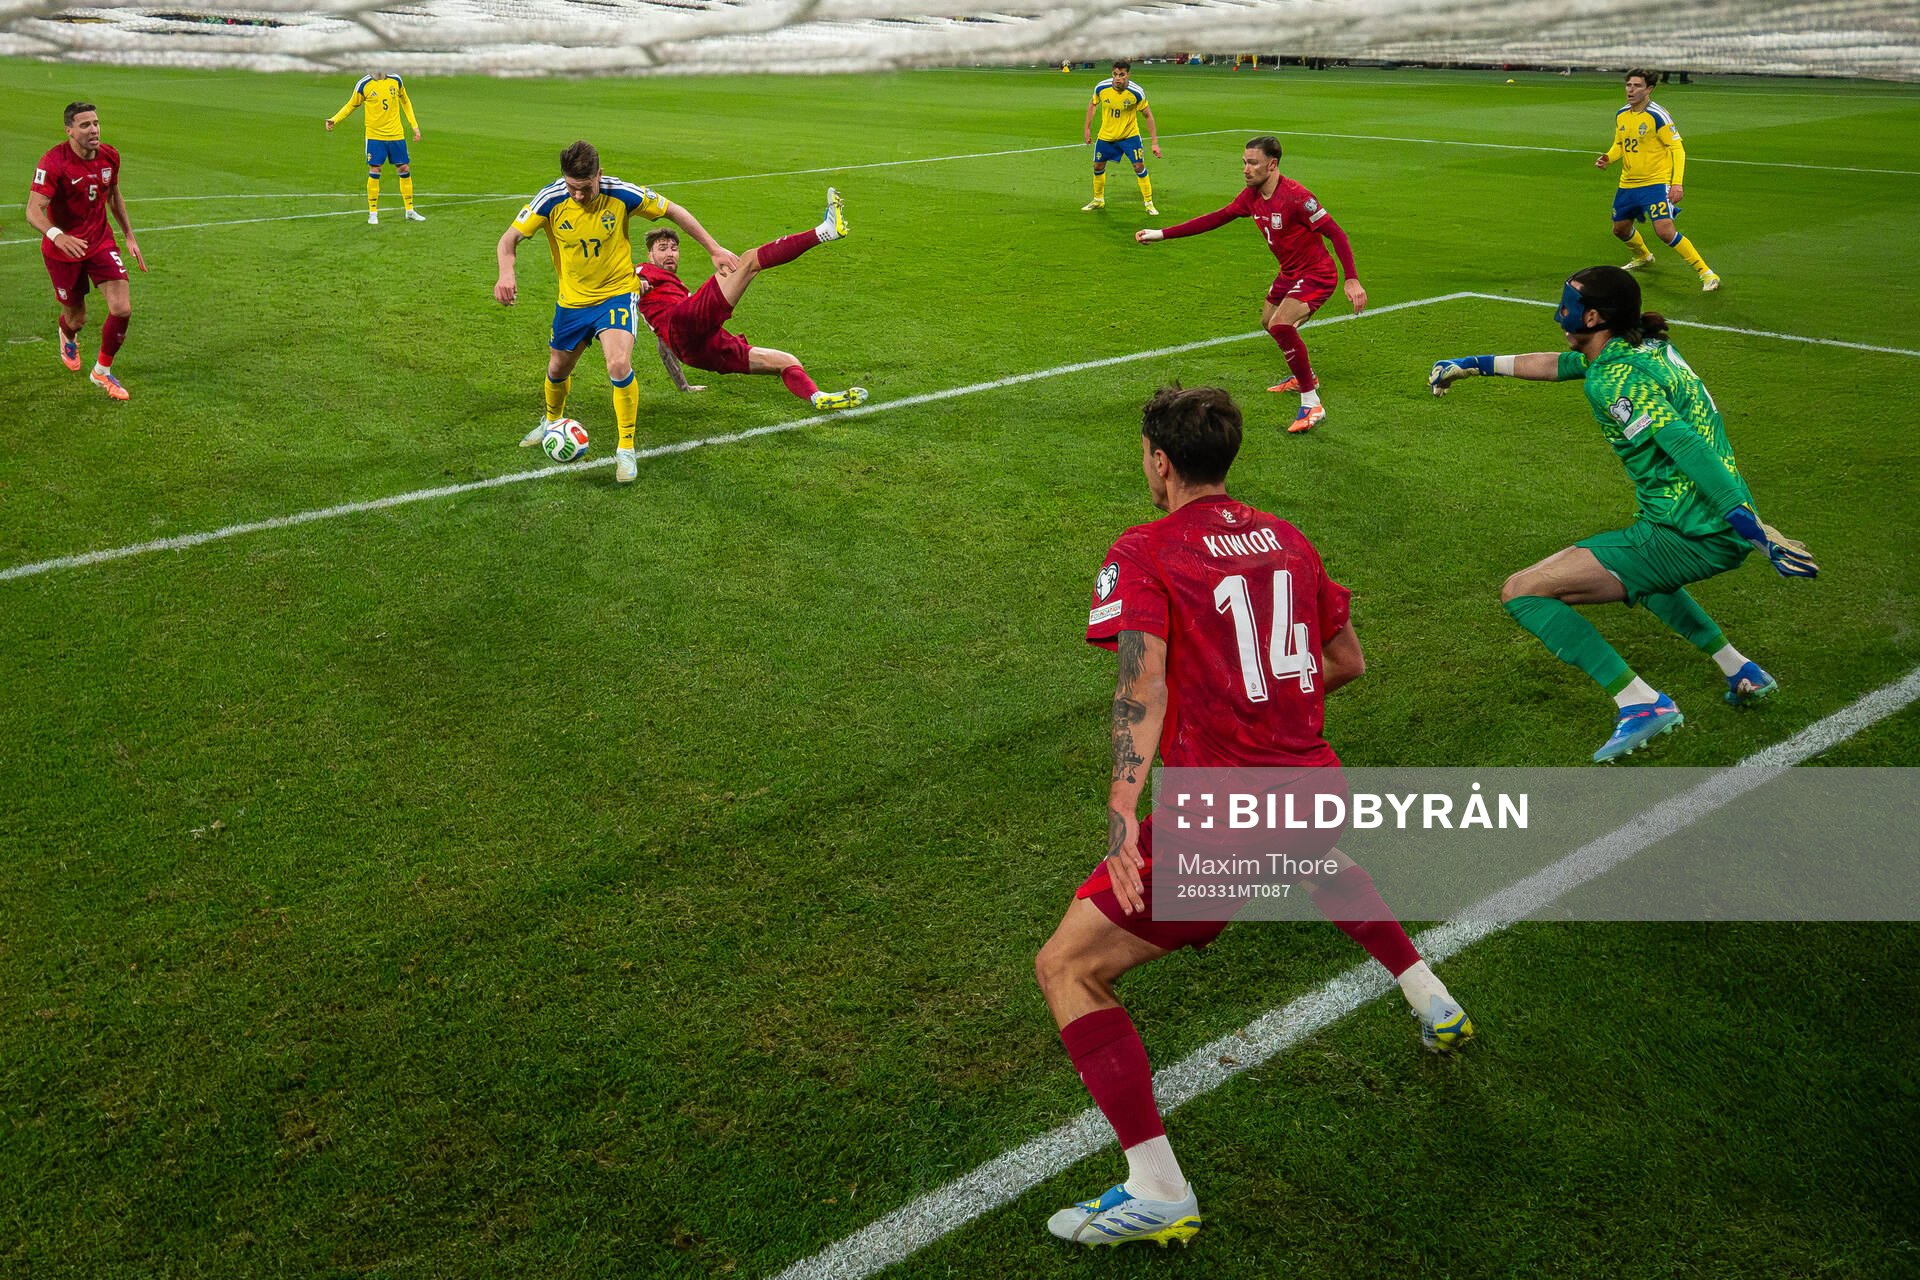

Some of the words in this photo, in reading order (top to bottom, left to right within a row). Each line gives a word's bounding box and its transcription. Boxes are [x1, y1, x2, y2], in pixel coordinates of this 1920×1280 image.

[382, 99, 389, 111] 5
[1111, 108, 1121, 118] 18
[1624, 138, 1639, 153] 22
[88, 184, 98, 201] 5
[1650, 201, 1669, 218] 22
[580, 238, 602, 258] 17
[109, 250, 123, 267] 5
[609, 307, 630, 326] 17
[1202, 527, 1283, 558] KIWIOR
[1213, 569, 1318, 702] 14
